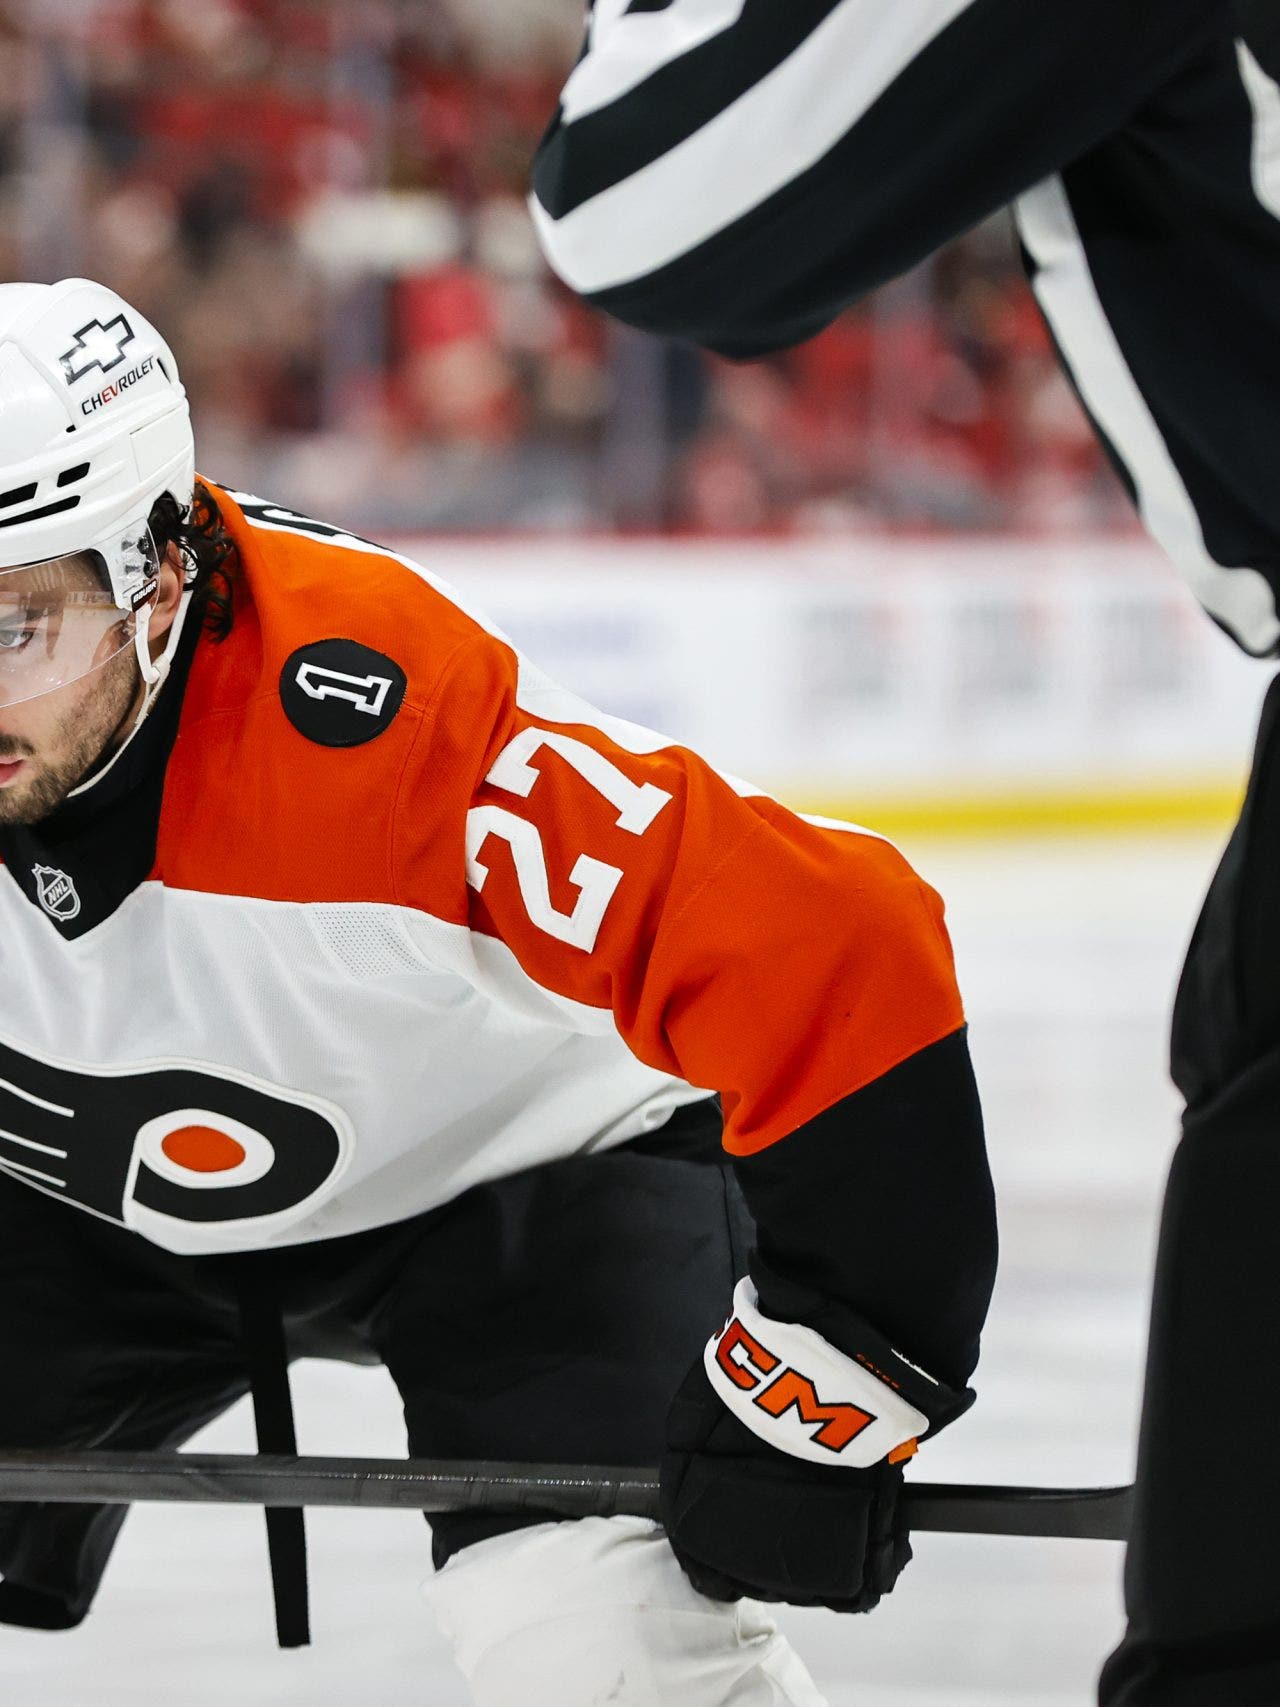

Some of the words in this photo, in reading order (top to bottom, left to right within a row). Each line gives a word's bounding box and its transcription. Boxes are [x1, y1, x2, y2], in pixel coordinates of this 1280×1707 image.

[81, 355, 154, 416] CHEVROLET
[295, 662, 393, 717] 1
[466, 726, 674, 955] 27
[47, 880, 69, 905] NHL
[714, 1313, 878, 1453] CM
